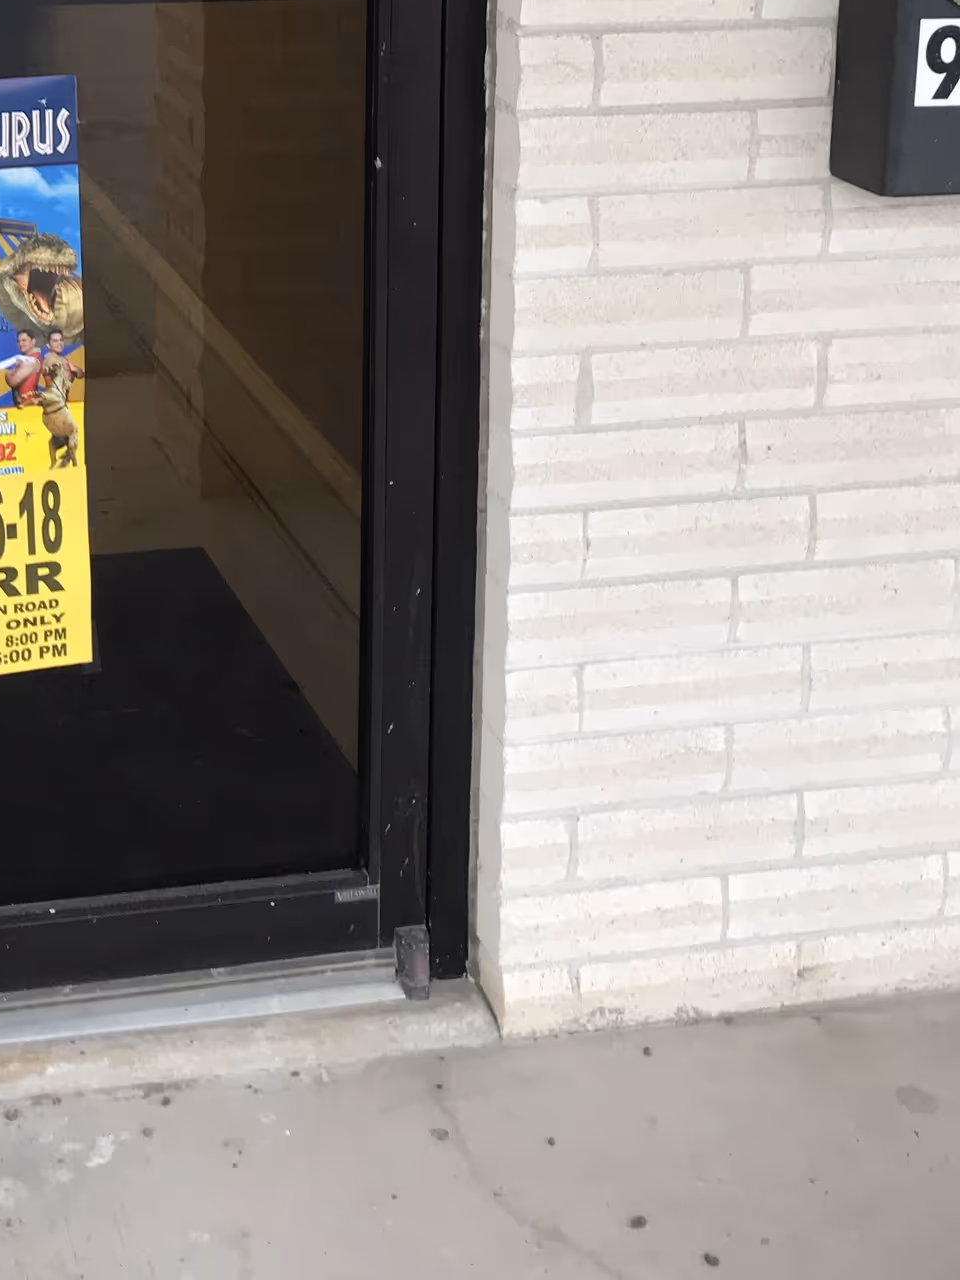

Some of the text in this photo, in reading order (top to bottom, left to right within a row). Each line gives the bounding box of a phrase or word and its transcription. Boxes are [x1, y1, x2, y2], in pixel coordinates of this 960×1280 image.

[13, 598, 60, 614] ROAD
[6, 612, 66, 630] ONLY
[5, 631, 39, 648] 8:00
[43, 627, 67, 642] PM
[39, 643, 68, 659] PM
